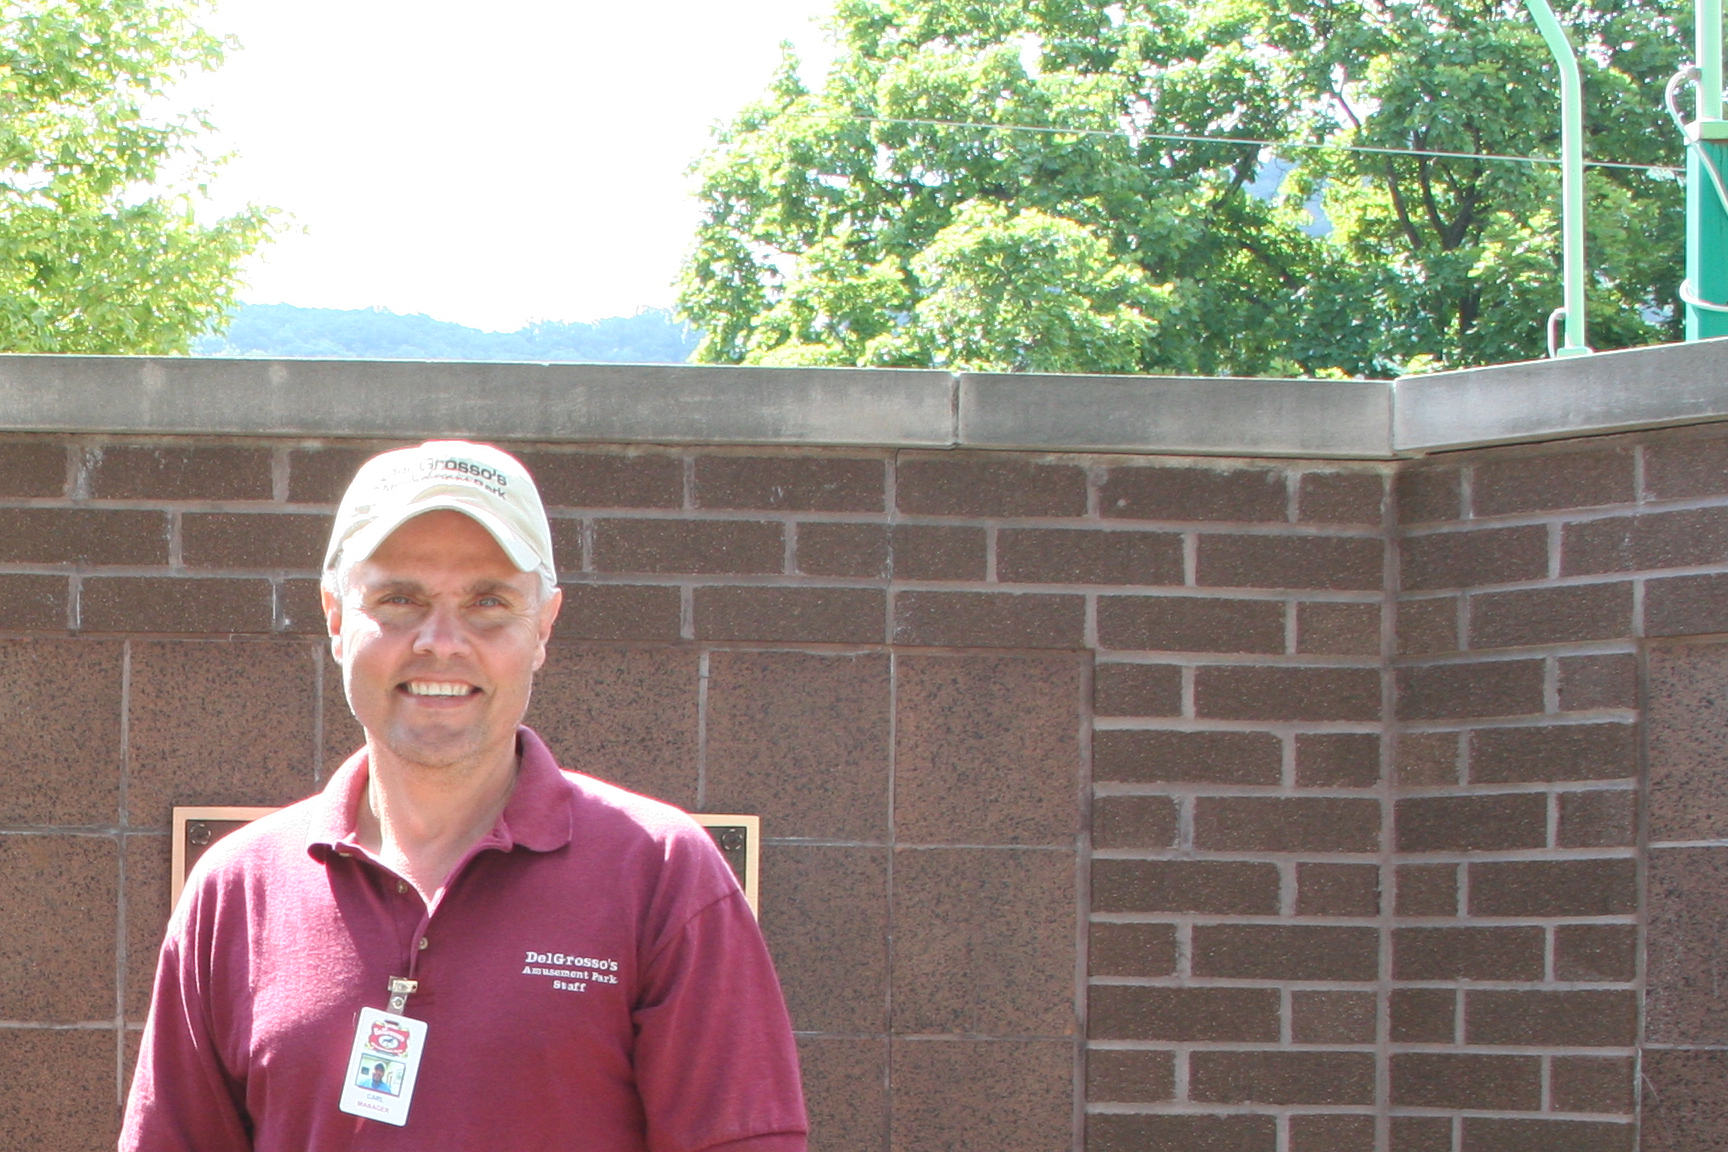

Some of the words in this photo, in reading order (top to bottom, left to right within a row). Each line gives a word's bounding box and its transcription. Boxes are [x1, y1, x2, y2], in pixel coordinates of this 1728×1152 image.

[524, 950, 619, 972] DelGrosso's
[521, 965, 590, 980] Amusement
[591, 971, 619, 985] Park
[553, 980, 587, 992] Staff
